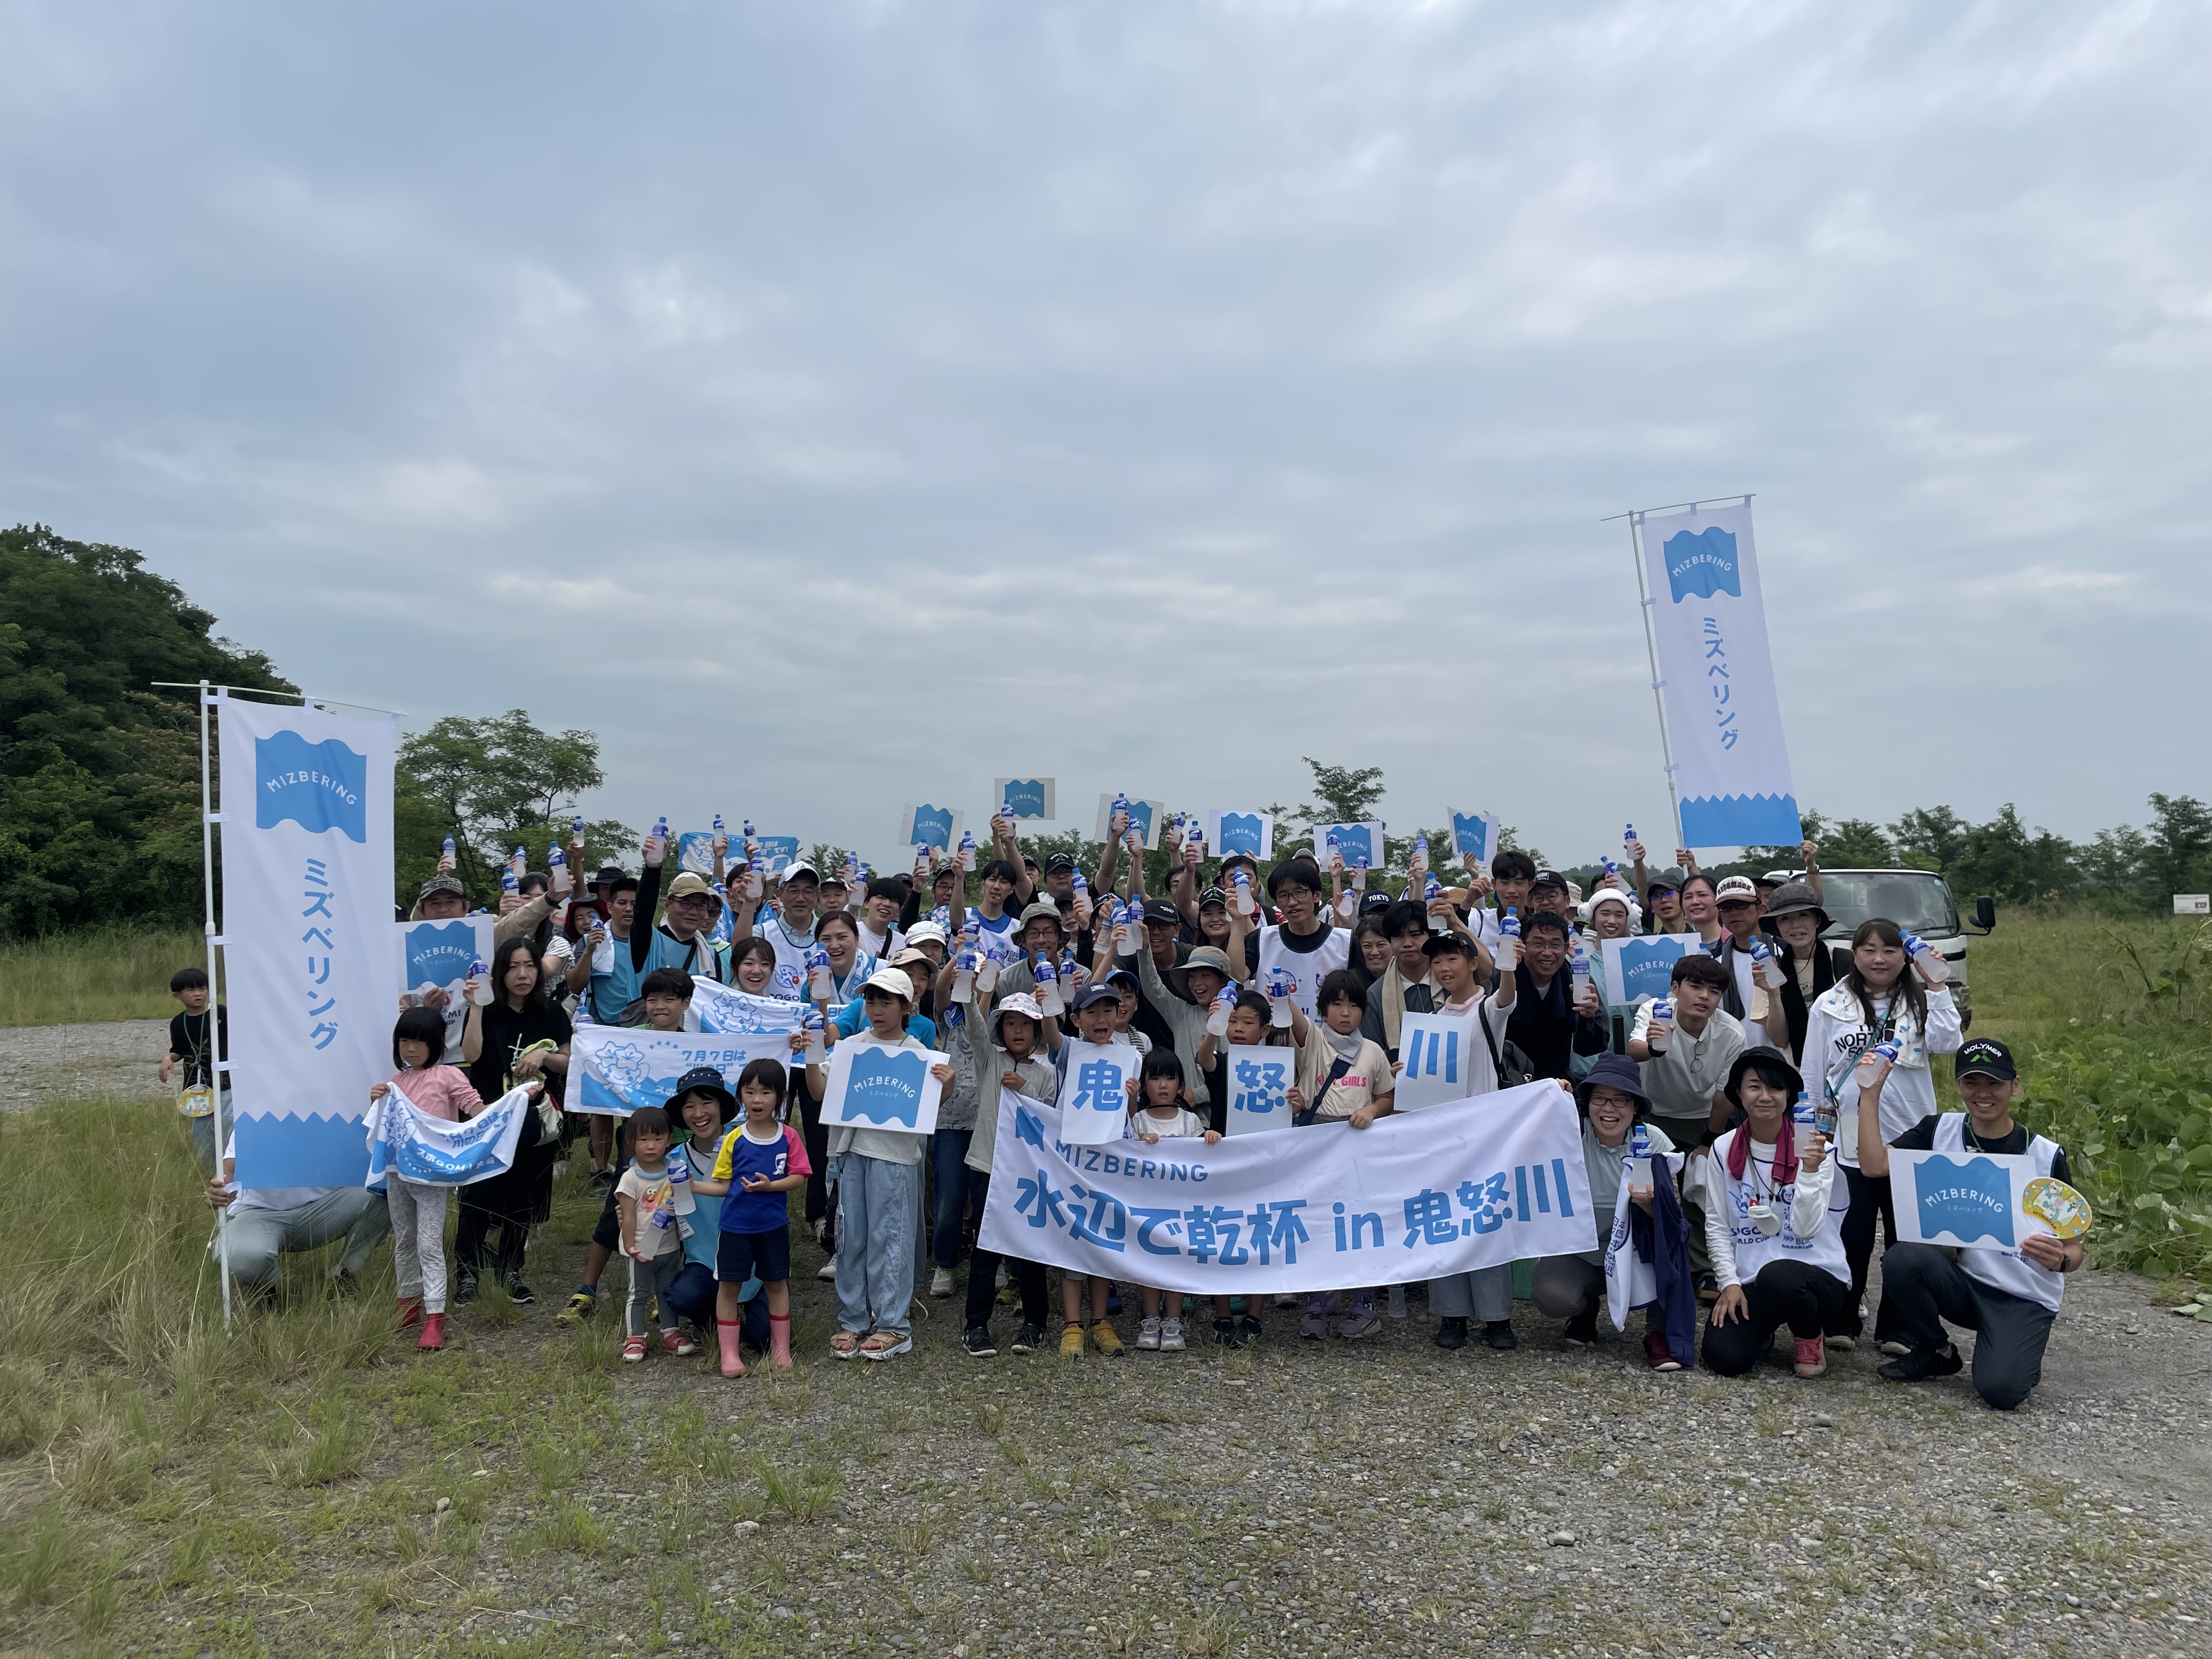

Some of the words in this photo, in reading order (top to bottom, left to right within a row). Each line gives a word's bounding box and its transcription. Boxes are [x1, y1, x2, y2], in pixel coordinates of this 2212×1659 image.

[1672, 554, 1733, 577] MIZBERING
[1703, 617, 1740, 751] ミズベリング
[266, 770, 357, 805] MIZBERING
[917, 821, 949, 836] MIZBERING
[1224, 828, 1259, 840] MIZBERING
[1339, 840, 1368, 851] ZBERING
[301, 858, 339, 1051] ミズベリング
[412, 945, 472, 965] MIZBERING
[1627, 960, 1675, 978] MIZBERIN
[682, 1049, 747, 1062] 7月7日は
[1405, 1029, 1459, 1084] 川
[1963, 1043, 2002, 1058] MOLYMER
[854, 1076, 916, 1098] MIZBERING
[1071, 1058, 1124, 1112] 鬼
[1234, 1059, 1286, 1114] 怒
[1341, 1076, 1367, 1087] GIRLS
[1056, 1138, 1209, 1182] MIZBERING
[1925, 1188, 2004, 1213] MIZBERING
[1013, 1169, 1310, 1267] 水辺で乾杯
[1334, 1201, 1384, 1252] in
[1403, 1158, 1576, 1250] 鬼怒川
